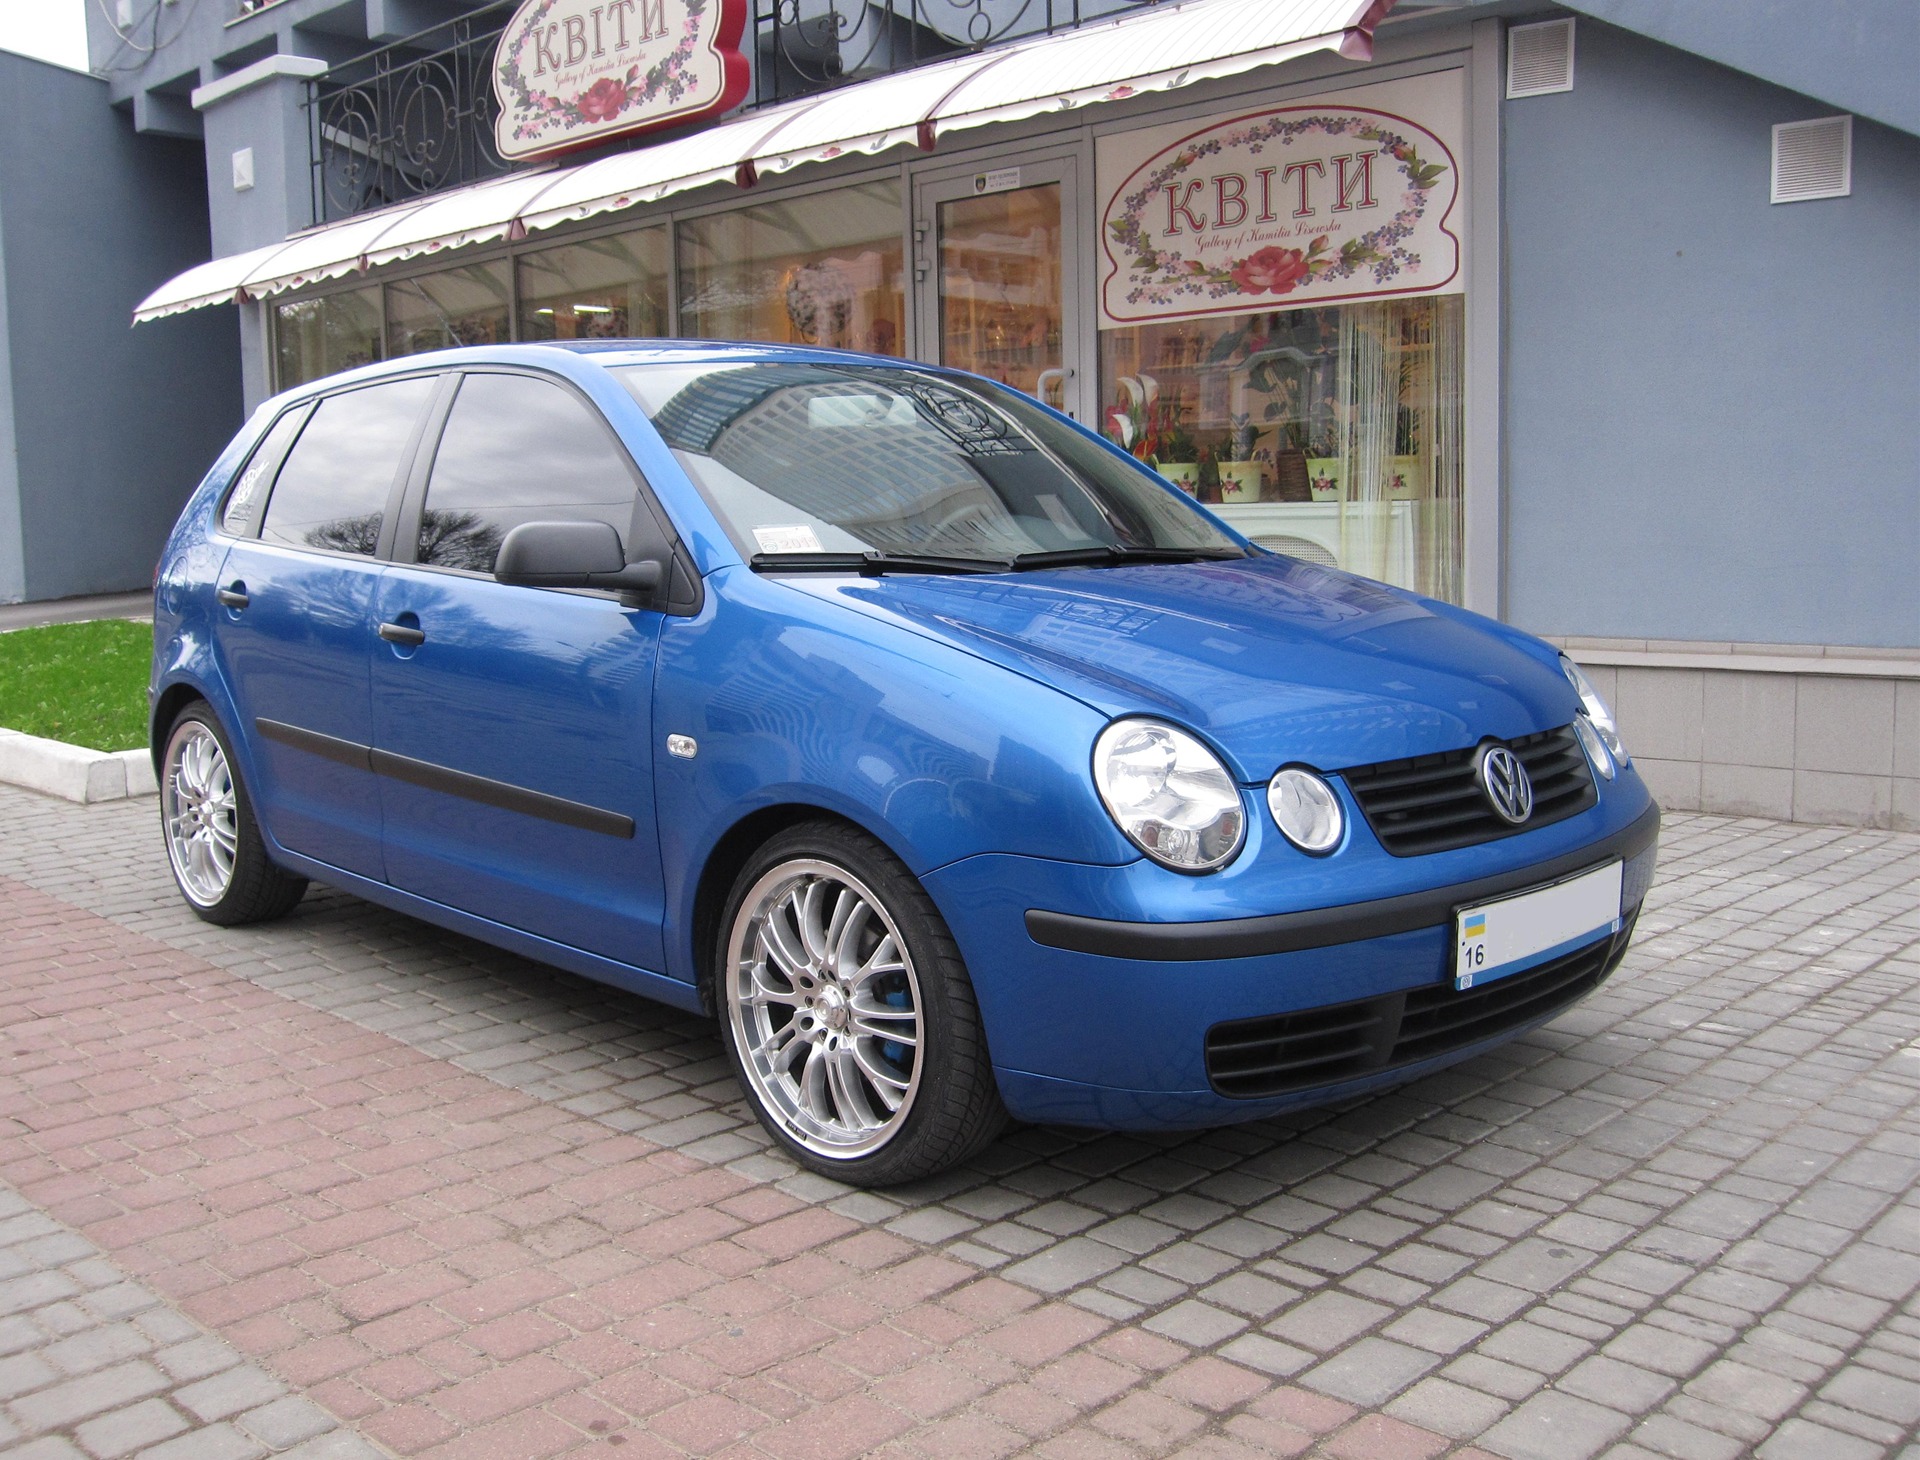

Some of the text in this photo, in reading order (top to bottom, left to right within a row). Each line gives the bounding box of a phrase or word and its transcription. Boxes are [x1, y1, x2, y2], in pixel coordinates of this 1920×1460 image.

[531, 0, 669, 77] КВІТИ
[554, 71, 578, 91] Gallery
[579, 68, 587, 84] of
[1162, 149, 1379, 237] КВІТИ
[1195, 233, 1233, 255] Gallery
[1234, 230, 1245, 250] of
[1246, 225, 1292, 243] Kamilia
[1465, 943, 1485, 969] 16
